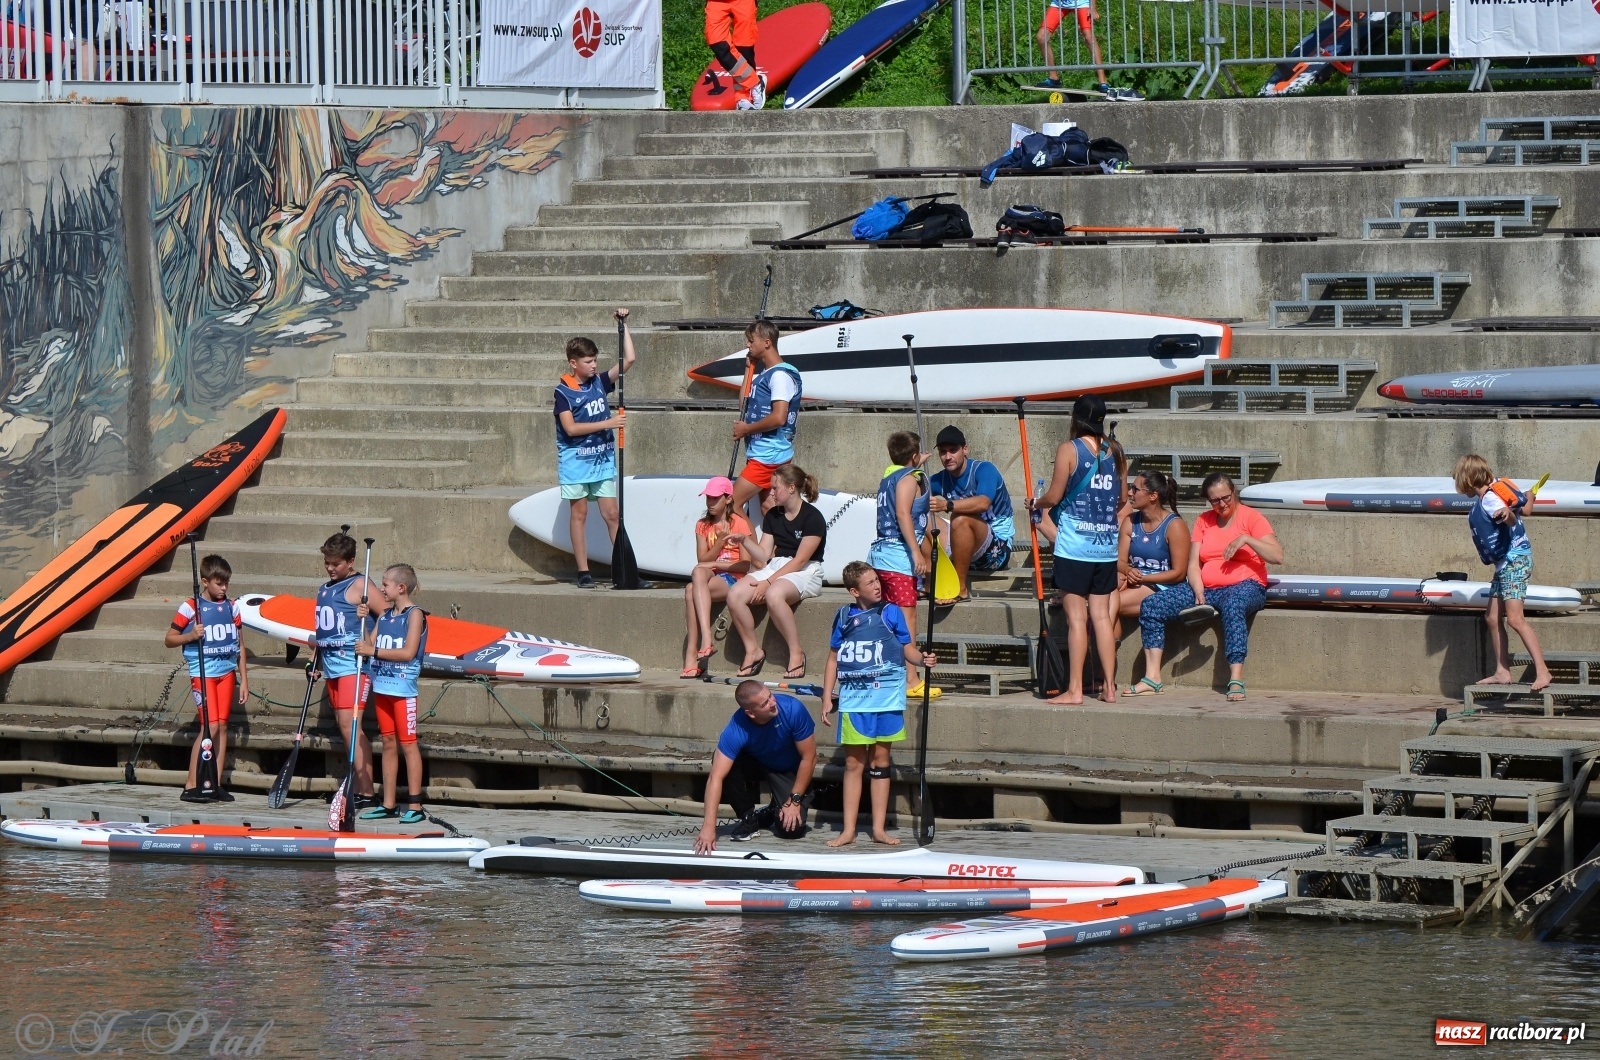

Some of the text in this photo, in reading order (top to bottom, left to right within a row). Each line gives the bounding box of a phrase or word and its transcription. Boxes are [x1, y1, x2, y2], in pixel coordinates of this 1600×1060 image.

[493, 23, 563, 42] www.zwsup.pl
[621, 24, 643, 32] Sportowy
[604, 33, 626, 46] SUP
[203, 623, 237, 642] 104
[947, 863, 1018, 878] PLASTEX
